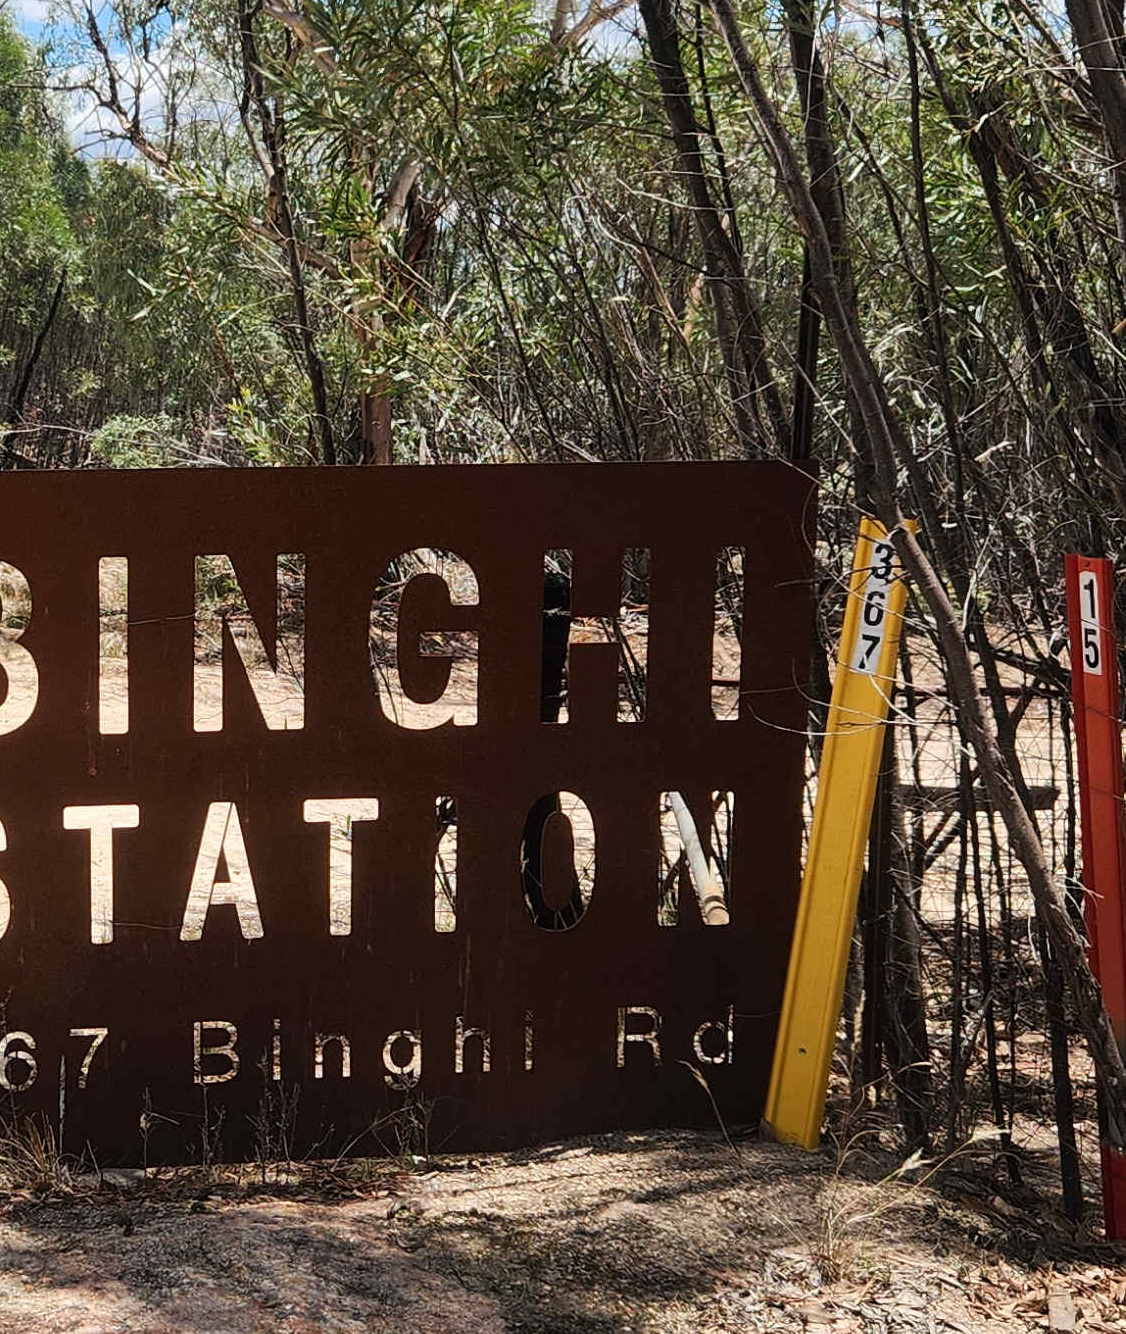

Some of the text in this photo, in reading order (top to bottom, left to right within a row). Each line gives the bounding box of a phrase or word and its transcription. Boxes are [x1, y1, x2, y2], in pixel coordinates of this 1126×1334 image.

[857, 543, 896, 670] 367
[1082, 577, 1100, 670] 15
[192, 1009, 534, 1091] Binghi
[616, 1003, 735, 1068] Rd
